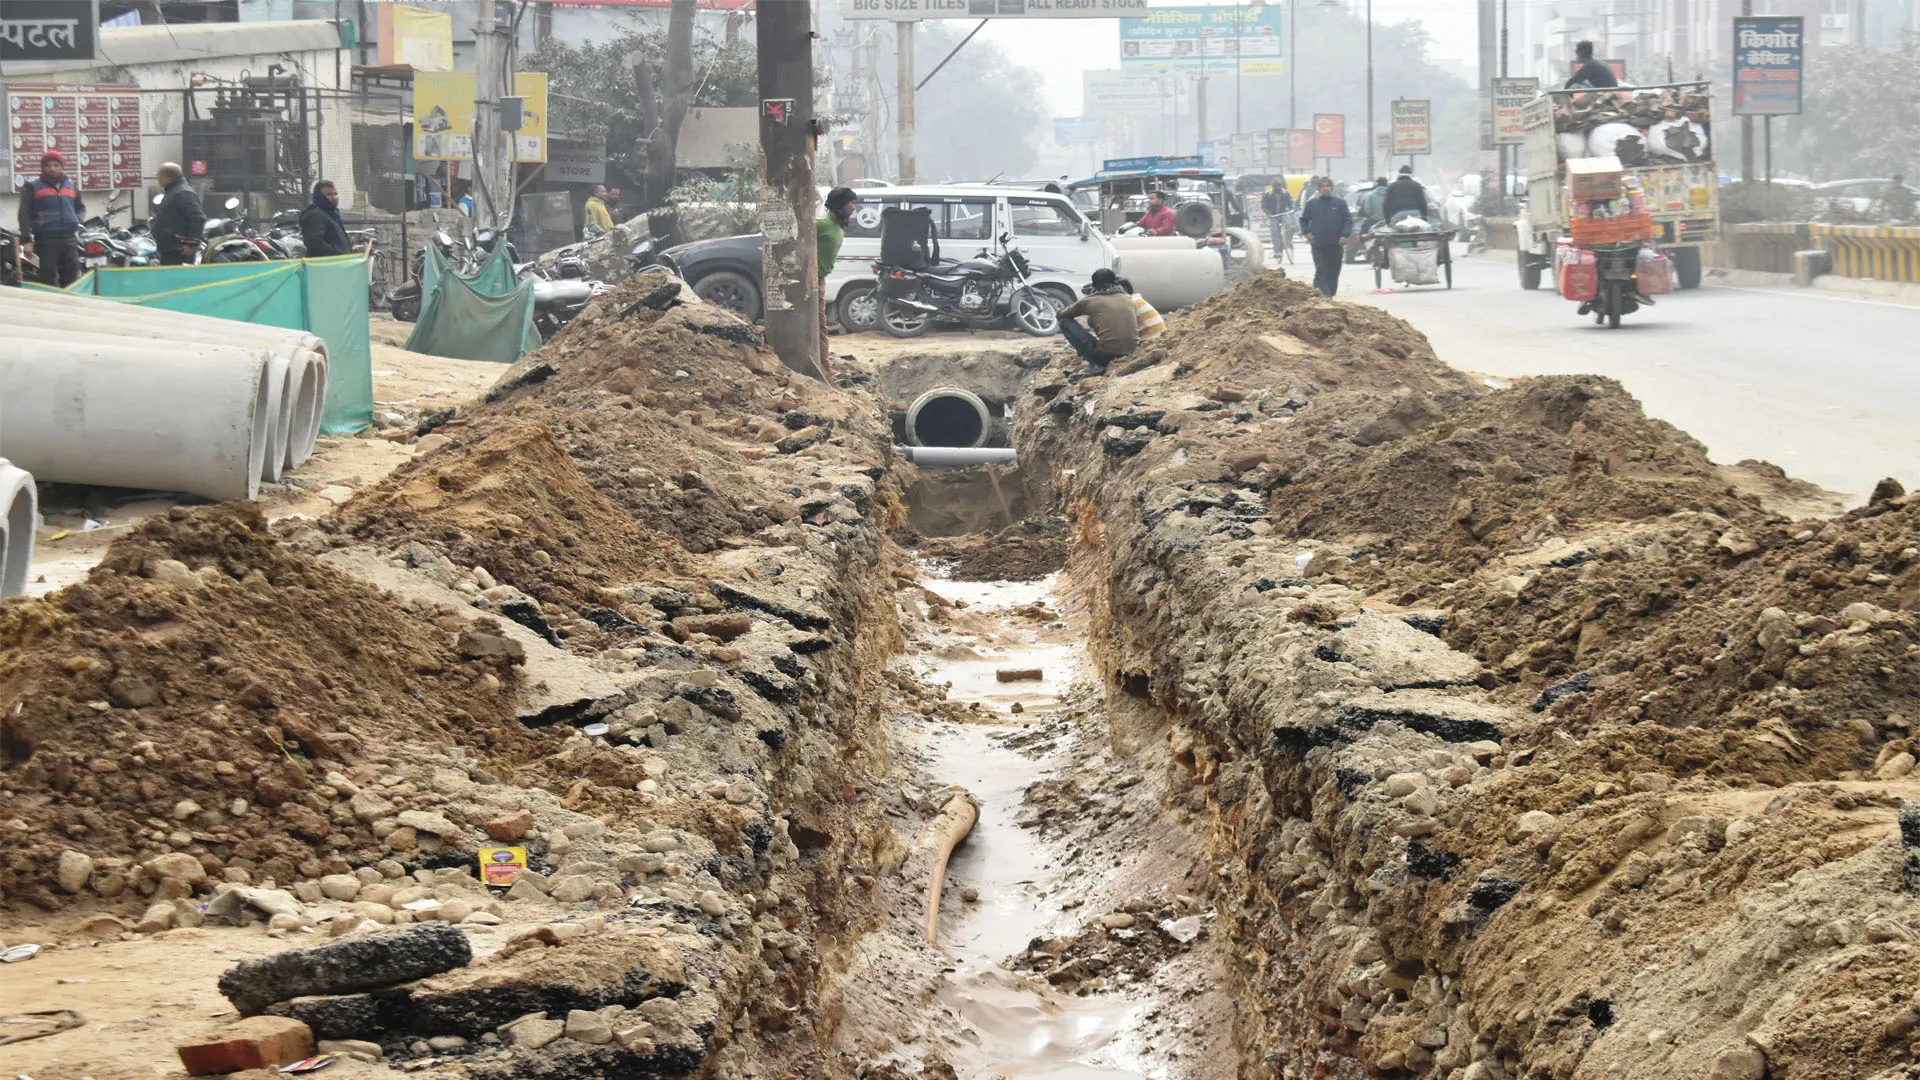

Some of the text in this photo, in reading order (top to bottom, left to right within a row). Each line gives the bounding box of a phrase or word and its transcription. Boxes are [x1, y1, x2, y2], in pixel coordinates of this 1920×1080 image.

[854, 0, 881, 10] BIG
[885, 0, 918, 10] SIZE
[925, 0, 965, 10] TILES
[1028, 0, 1052, 9] ALL
[1056, 0, 1098, 9] READY
[1102, 0, 1145, 9] STOCK
[1739, 29, 1800, 48] किशोर
[559, 166, 592, 177] STORE
